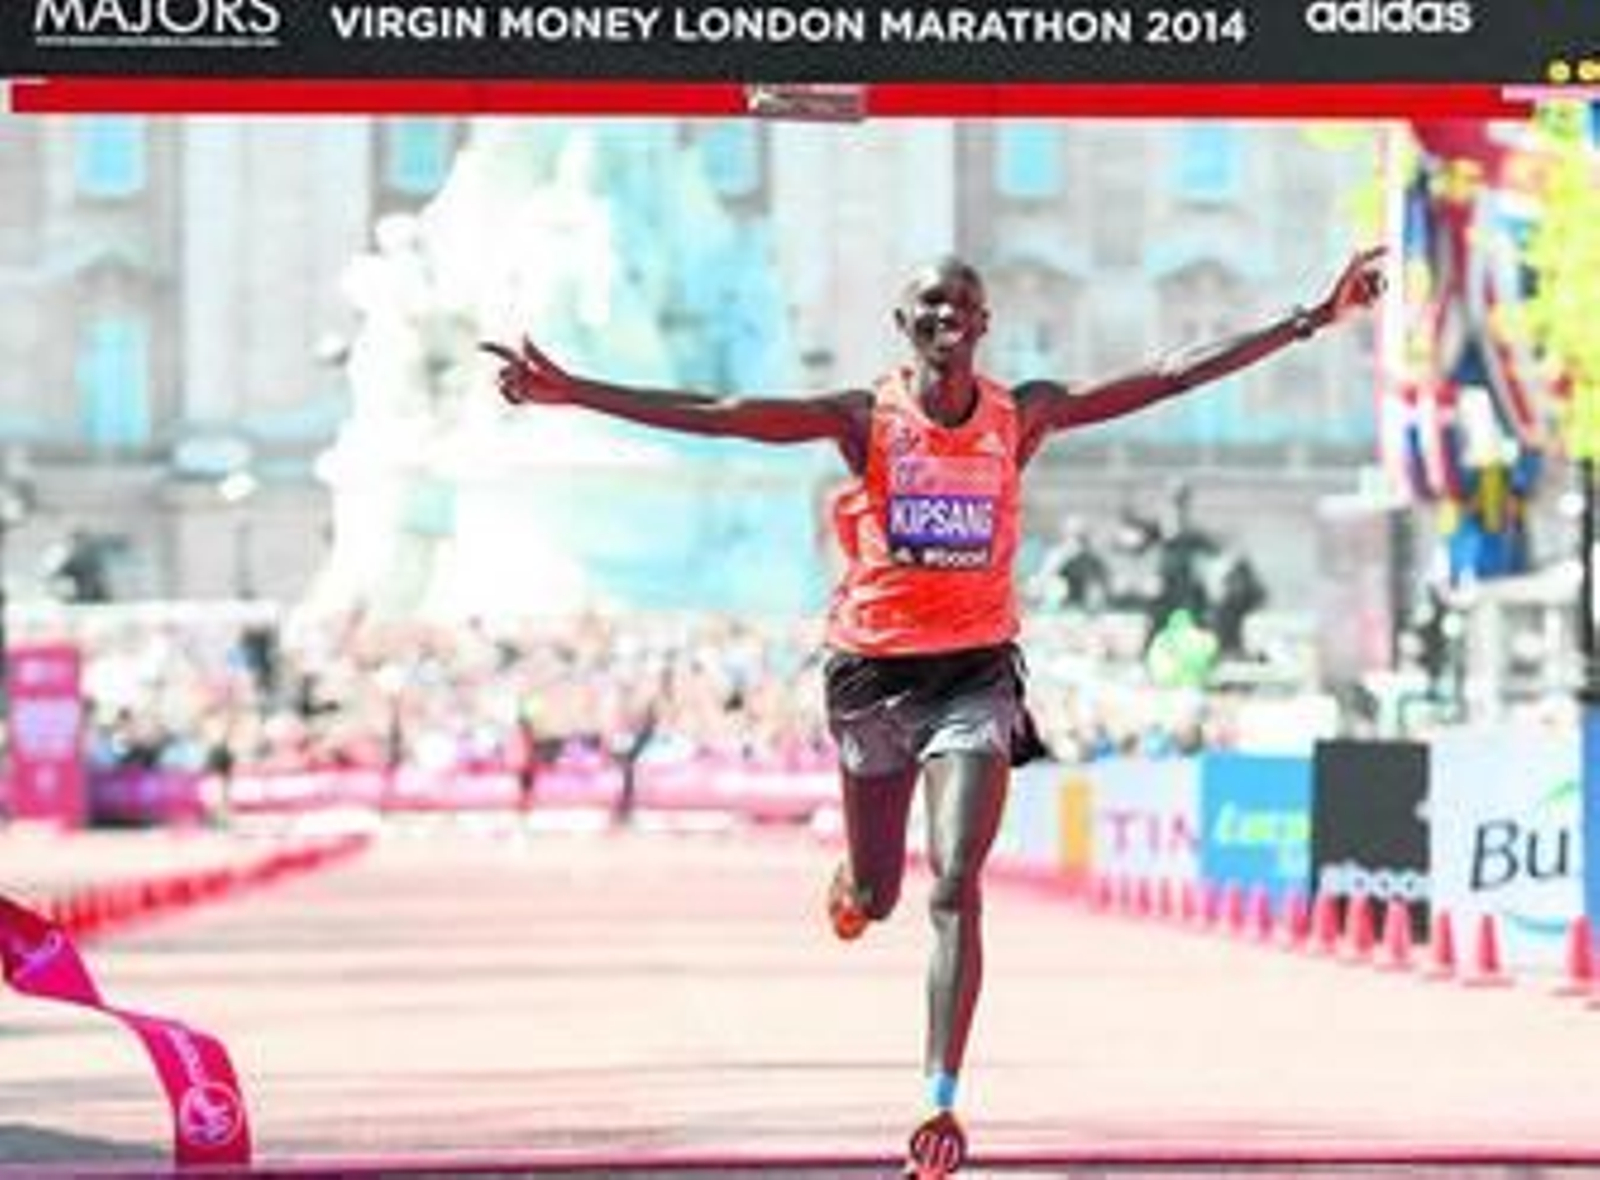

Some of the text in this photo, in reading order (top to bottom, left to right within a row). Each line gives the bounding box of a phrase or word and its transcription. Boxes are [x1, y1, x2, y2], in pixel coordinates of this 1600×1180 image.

[34, 0, 281, 33] MAJORS
[330, 6, 1247, 43] VIRGIN MONEY LONDON MARATHON 2014
[1305, 0, 1473, 33] adidas
[890, 499, 994, 540] KIPSANG
[1469, 818, 1570, 893] Bu
